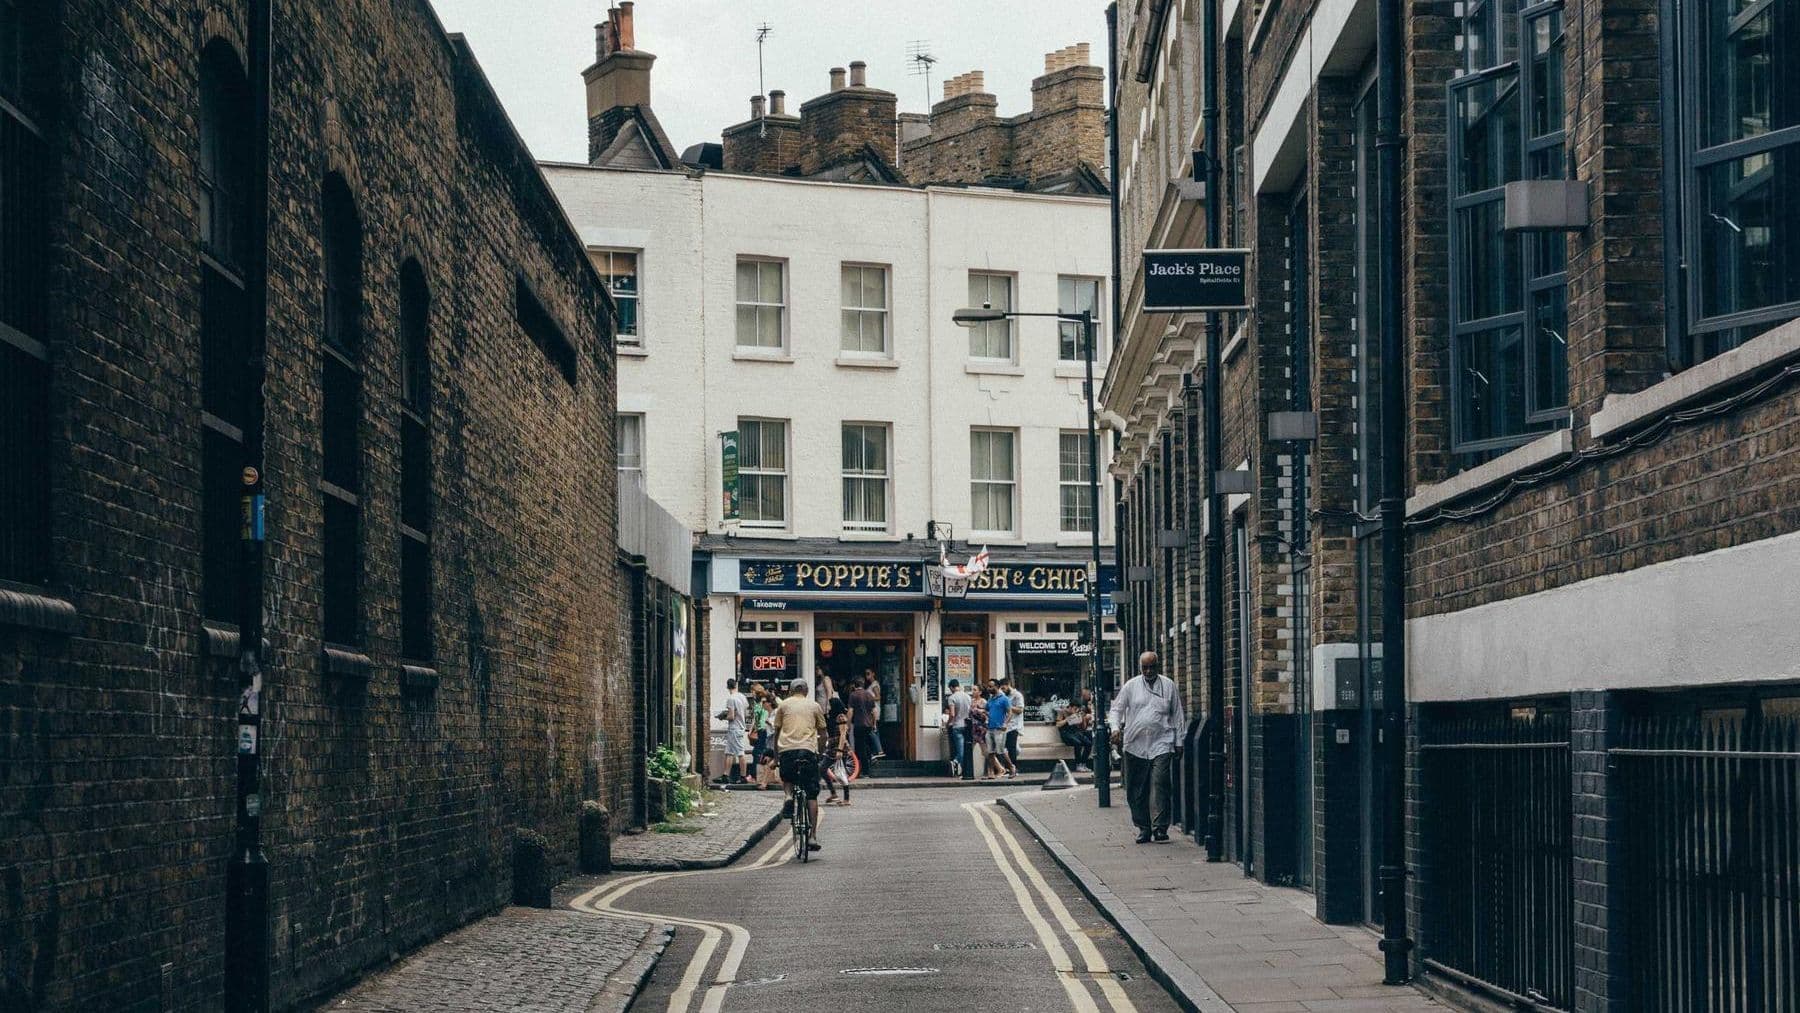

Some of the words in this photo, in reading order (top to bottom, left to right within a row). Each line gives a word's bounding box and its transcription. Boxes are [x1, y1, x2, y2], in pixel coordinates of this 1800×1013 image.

[1149, 263, 1195, 275] Jack's
[1199, 263, 1241, 275] Place
[796, 563, 911, 588] POPPIE'S
[1013, 570, 1025, 585] &
[752, 599, 787, 610] Takeaway
[1019, 642, 1056, 650] WELCOME
[1057, 642, 1068, 650] TO
[754, 656, 786, 670] OPEN
